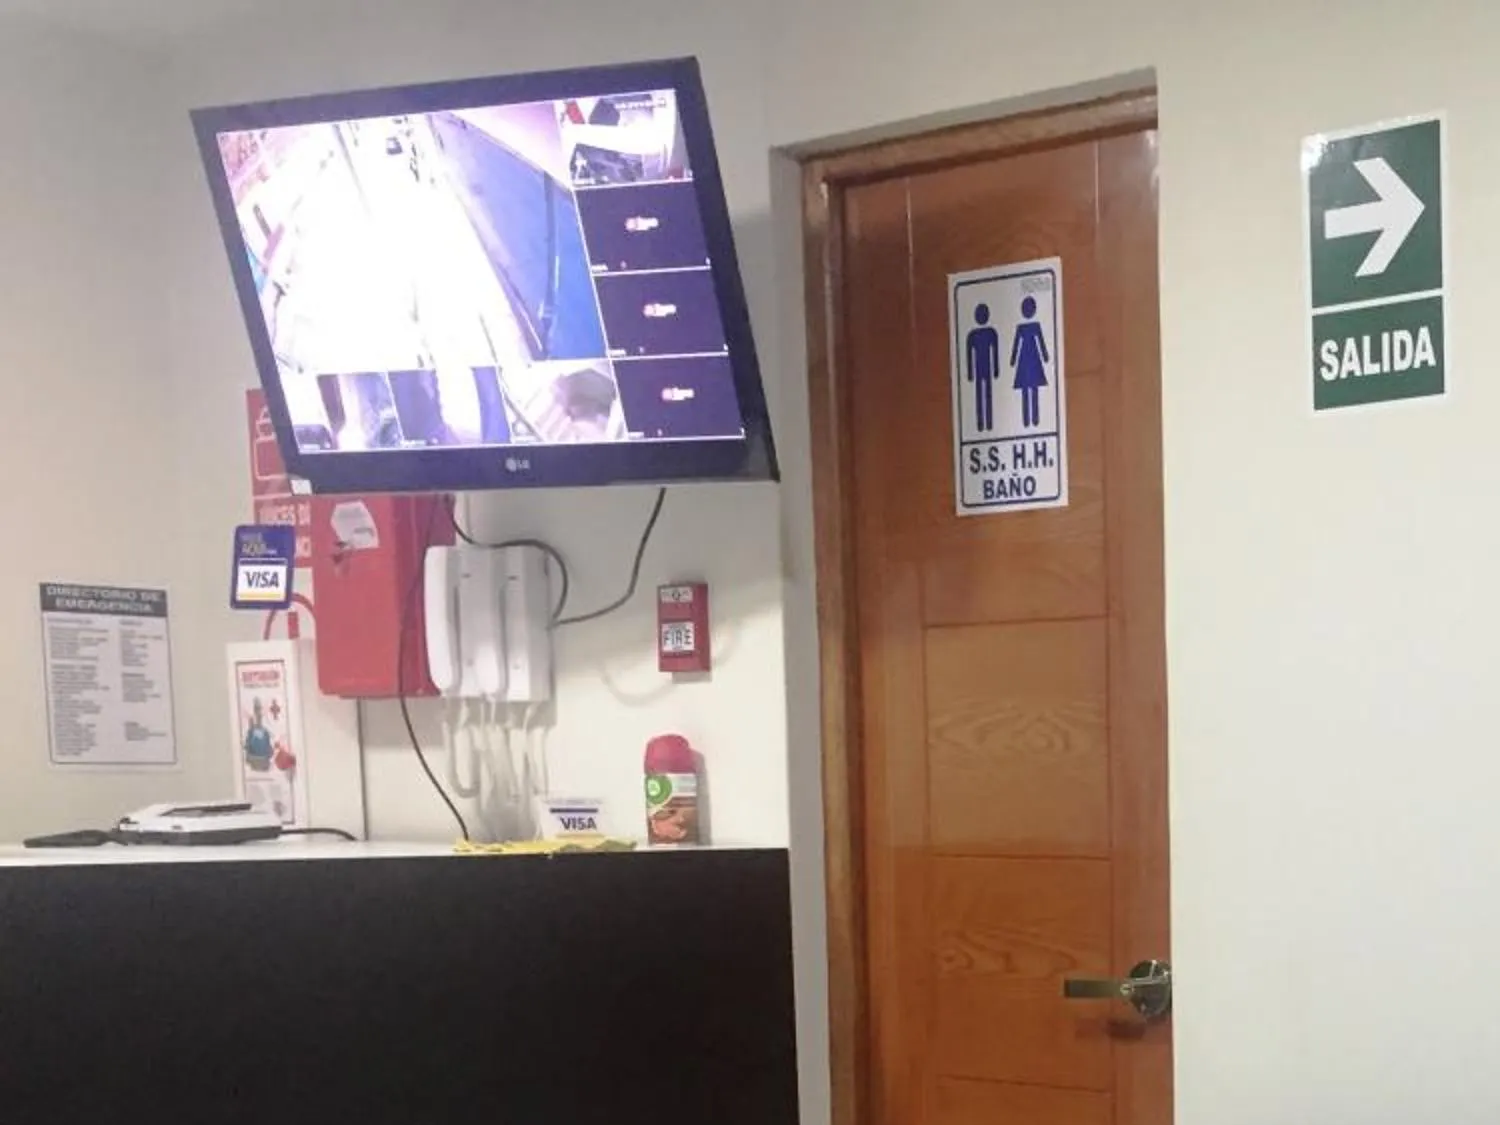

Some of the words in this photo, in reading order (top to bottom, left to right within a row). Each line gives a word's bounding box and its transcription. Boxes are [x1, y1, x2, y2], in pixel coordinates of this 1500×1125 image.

[1319, 326, 1437, 382] SALIDA
[969, 446, 1007, 474] S.S.
[1013, 441, 1055, 470] H.H.
[983, 473, 1037, 499] BAÑO
[245, 570, 280, 589] VISA
[663, 628, 693, 646] FIRE
[559, 816, 598, 831] VISA
